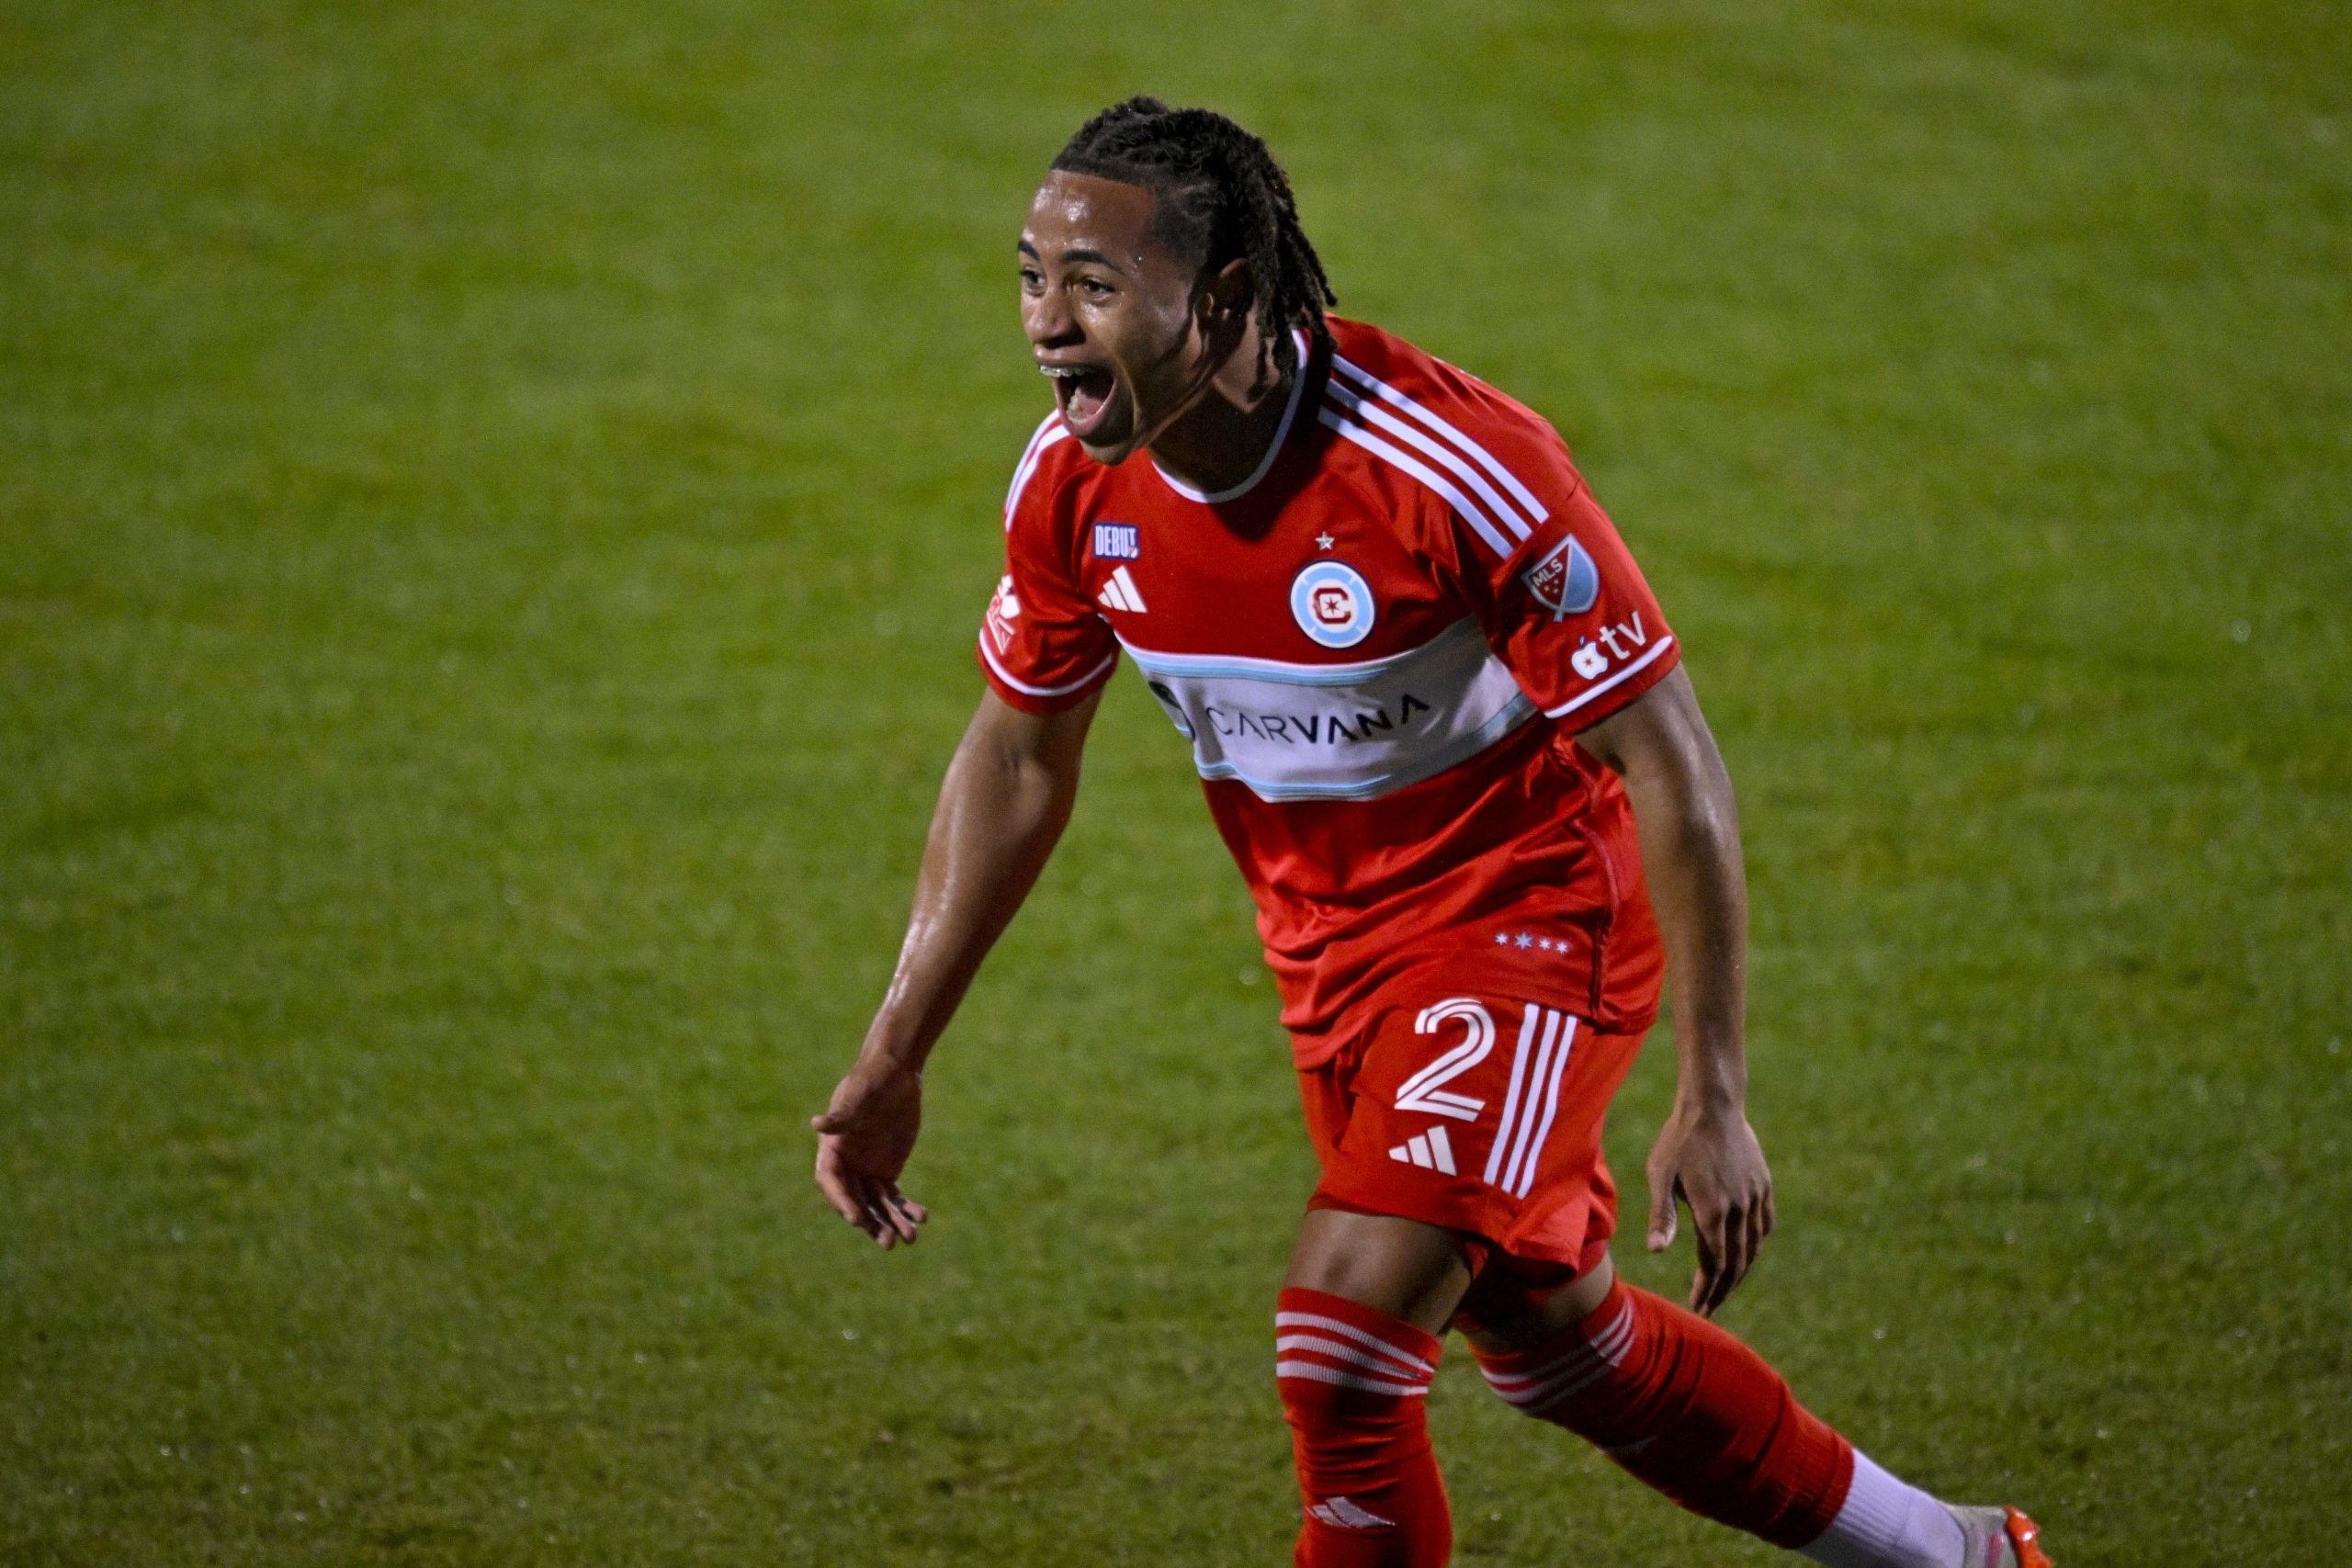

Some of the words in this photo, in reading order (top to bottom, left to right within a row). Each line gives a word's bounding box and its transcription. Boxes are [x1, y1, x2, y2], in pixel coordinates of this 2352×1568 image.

[1095, 525, 1137, 558] DEBUT
[1532, 558, 1564, 587] MLS
[1599, 610, 1647, 660] tv
[1205, 694, 1430, 744] CARVANA
[1394, 996, 1496, 1122] 2
